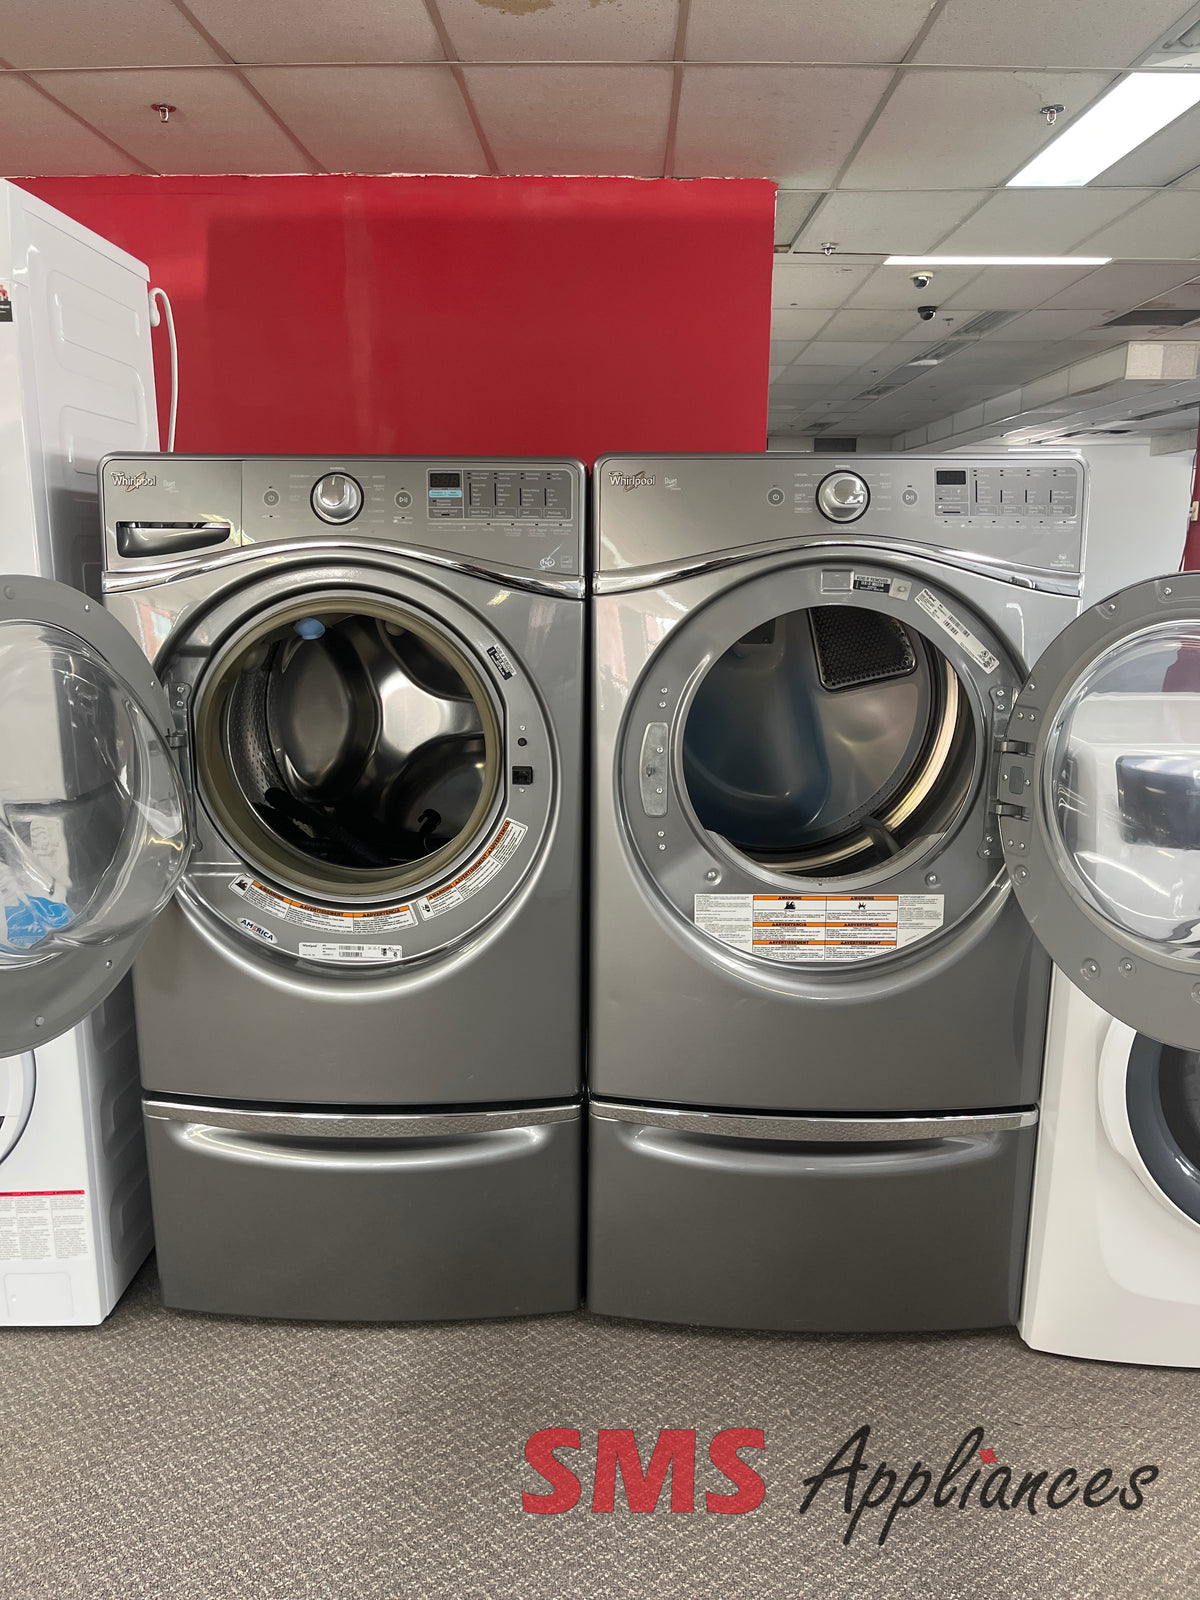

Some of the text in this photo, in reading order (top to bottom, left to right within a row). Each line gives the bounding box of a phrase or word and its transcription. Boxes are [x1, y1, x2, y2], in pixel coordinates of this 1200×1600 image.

[110, 471, 157, 492] Whirlpool
[608, 471, 657, 492] Whirlpool
[240, 919, 274, 941] AMERICA
